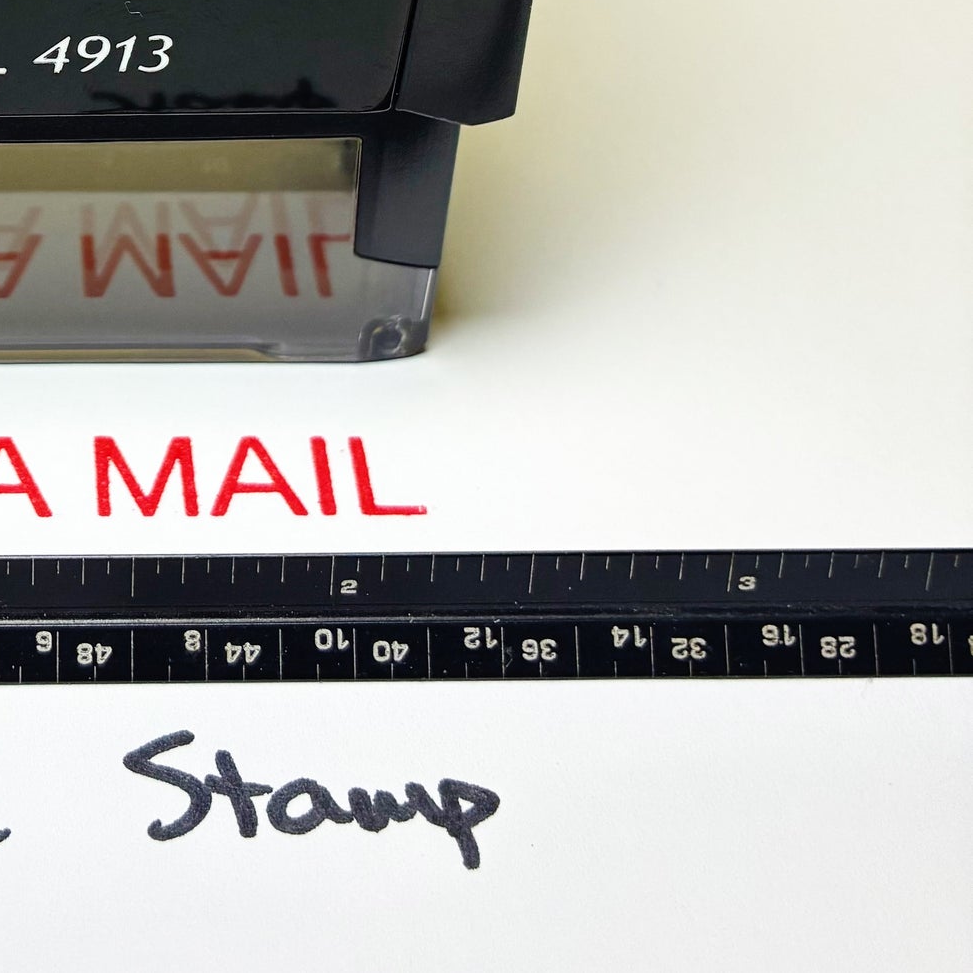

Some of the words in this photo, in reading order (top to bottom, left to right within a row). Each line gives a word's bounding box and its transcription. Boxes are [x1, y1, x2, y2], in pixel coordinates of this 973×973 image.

[33, 35, 173, 73] 4913
[94, 436, 427, 517] MAIL
[341, 580, 357, 593] 2
[739, 577, 755, 590] 3
[36, 631, 52, 652] 6
[184, 630, 201, 651] 8
[315, 629, 349, 650] 10
[464, 627, 497, 648] 12
[612, 626, 646, 647] 14
[762, 625, 795, 645] 16
[910, 624, 944, 645] 18
[77, 643, 112, 664] 48
[225, 642, 261, 663] 44
[373, 641, 408, 662] 40
[522, 639, 556, 660] 36
[672, 638, 706, 659] 32
[821, 637, 855, 658] 28
[123, 731, 500, 869] Stamp
